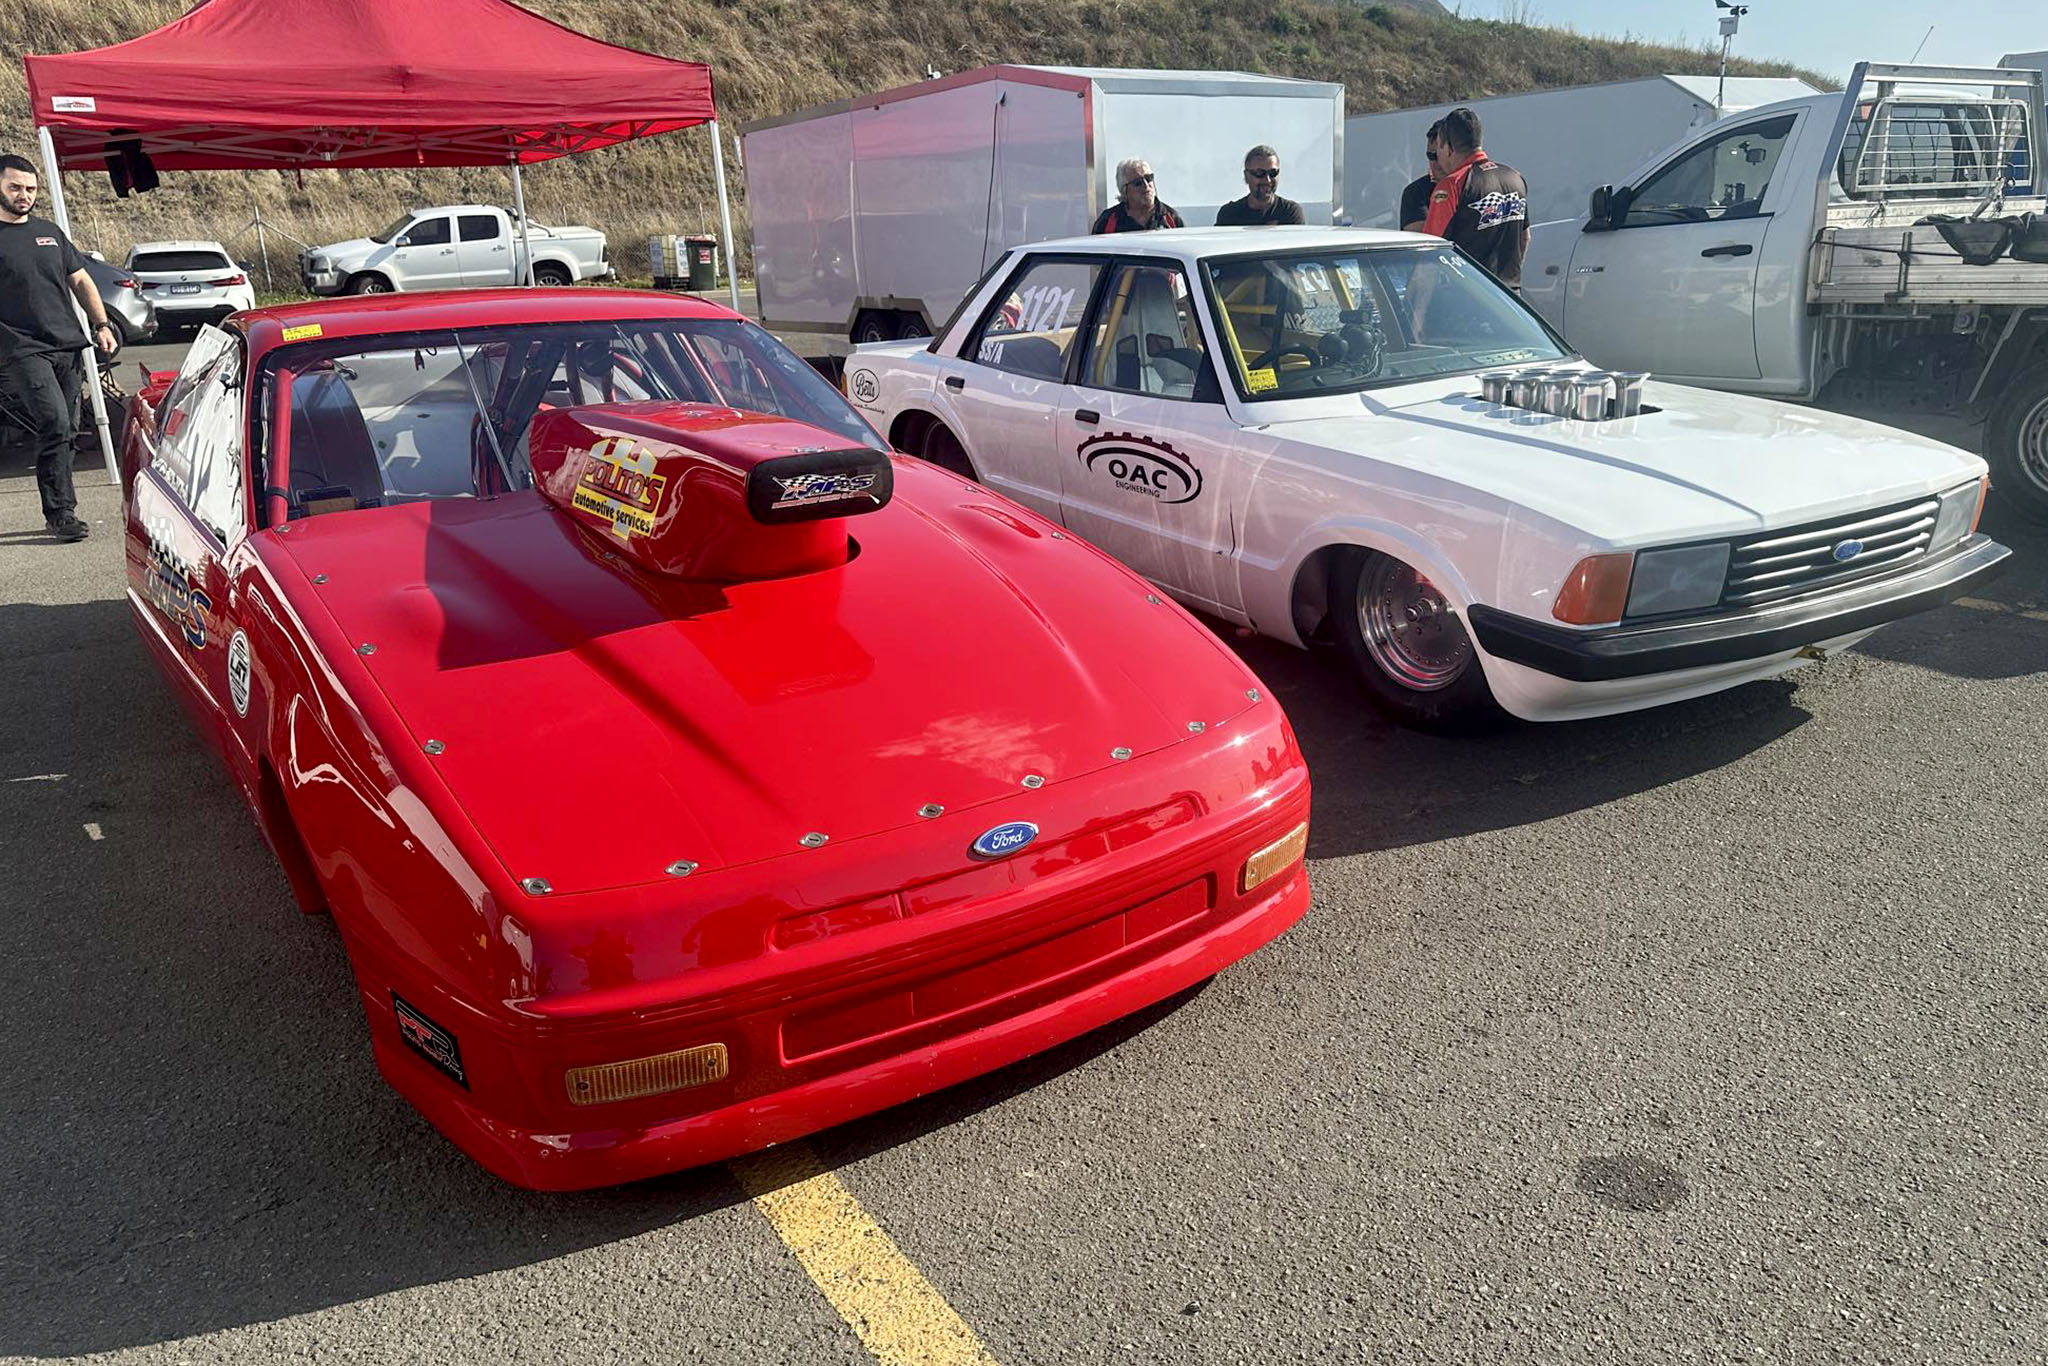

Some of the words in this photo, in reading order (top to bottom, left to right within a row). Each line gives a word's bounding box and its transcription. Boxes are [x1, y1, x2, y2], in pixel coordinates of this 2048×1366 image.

[1016, 285, 1075, 333] 1121
[978, 340, 1004, 364] SS/A
[580, 459, 664, 513] POLITO'S
[1108, 459, 1168, 490] OAC
[1115, 480, 1160, 498] ENGINEERING
[575, 492, 615, 520] automotive
[616, 508, 650, 533] services
[992, 828, 1024, 849] Ford
